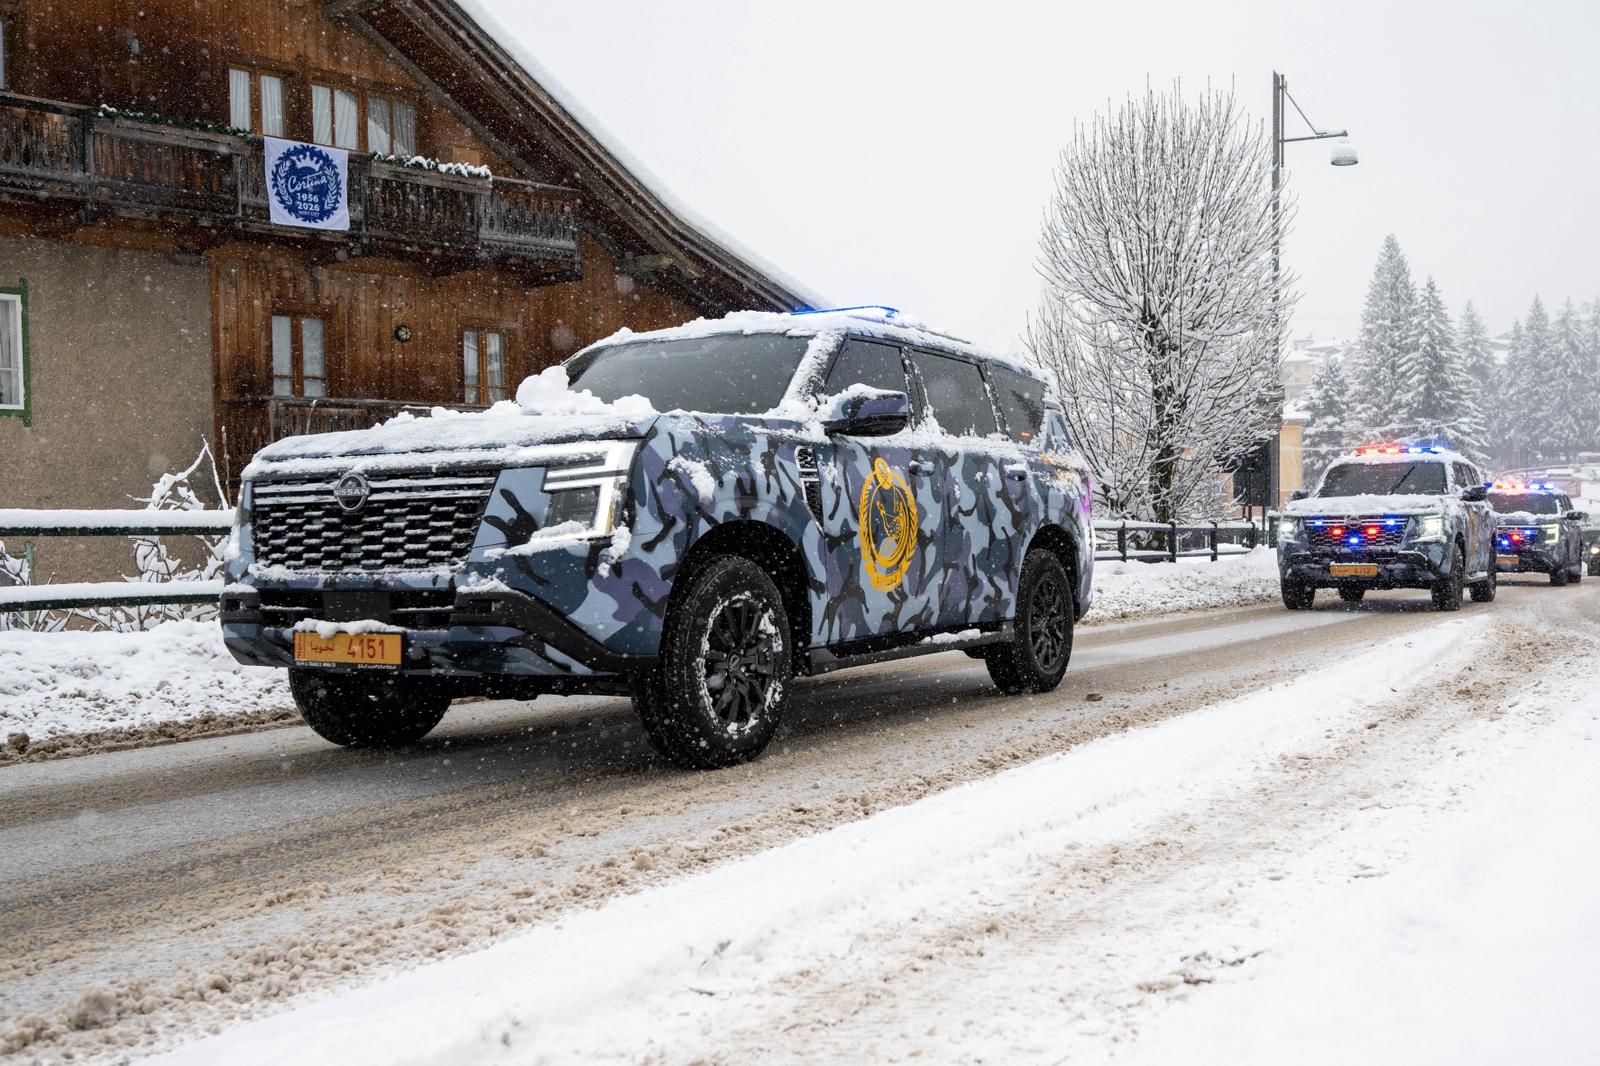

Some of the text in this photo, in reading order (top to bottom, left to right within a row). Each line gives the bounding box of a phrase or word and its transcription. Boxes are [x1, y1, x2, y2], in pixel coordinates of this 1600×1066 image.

[288, 171, 327, 192] Cortina
[296, 193, 319, 203] 1956
[297, 202, 320, 211] 2026
[334, 488, 369, 496] NISSAN
[347, 638, 385, 660] 4151
